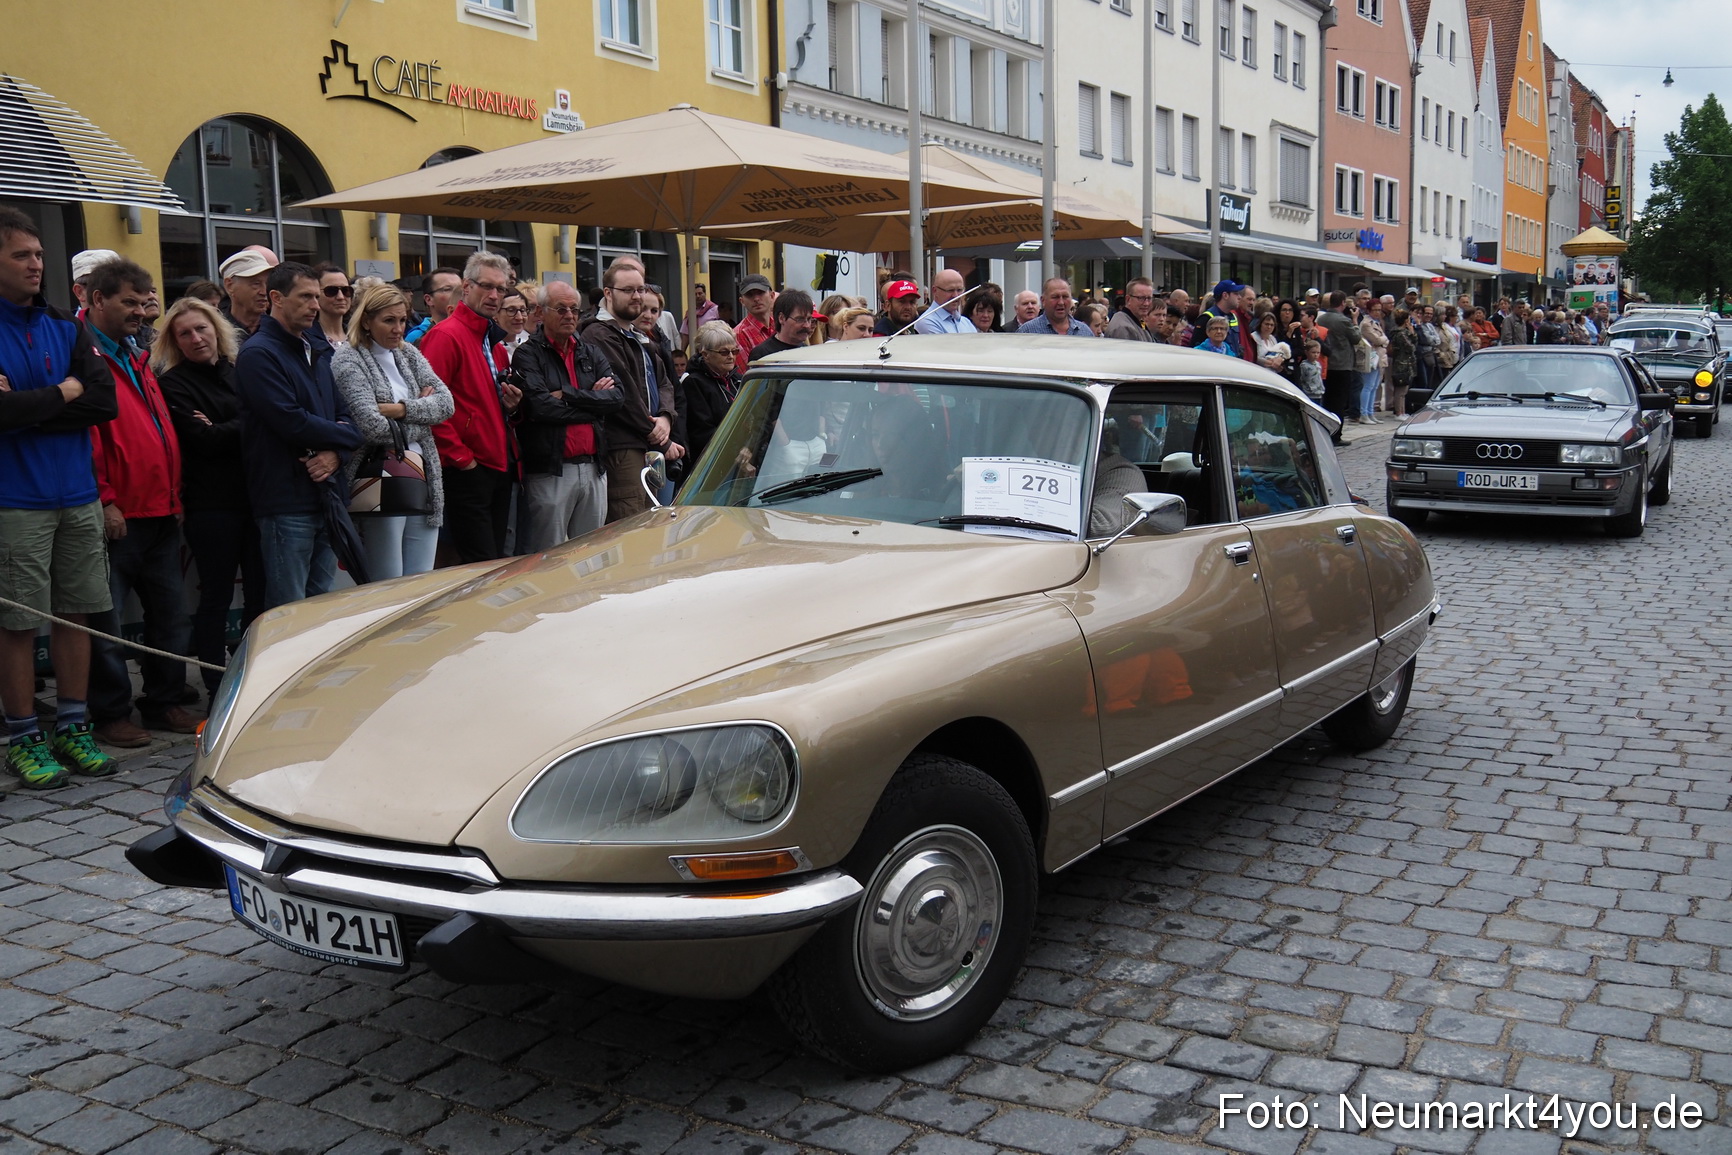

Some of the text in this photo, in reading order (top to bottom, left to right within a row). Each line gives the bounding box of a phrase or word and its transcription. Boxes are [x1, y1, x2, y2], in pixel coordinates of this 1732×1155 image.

[373, 55, 539, 121] CAFÉ AM RATHAUS
[762, 258, 771, 269] 24
[1022, 474, 1059, 495] 278
[1465, 473, 1491, 487] ROD
[238, 877, 399, 958] FO PW 21H
